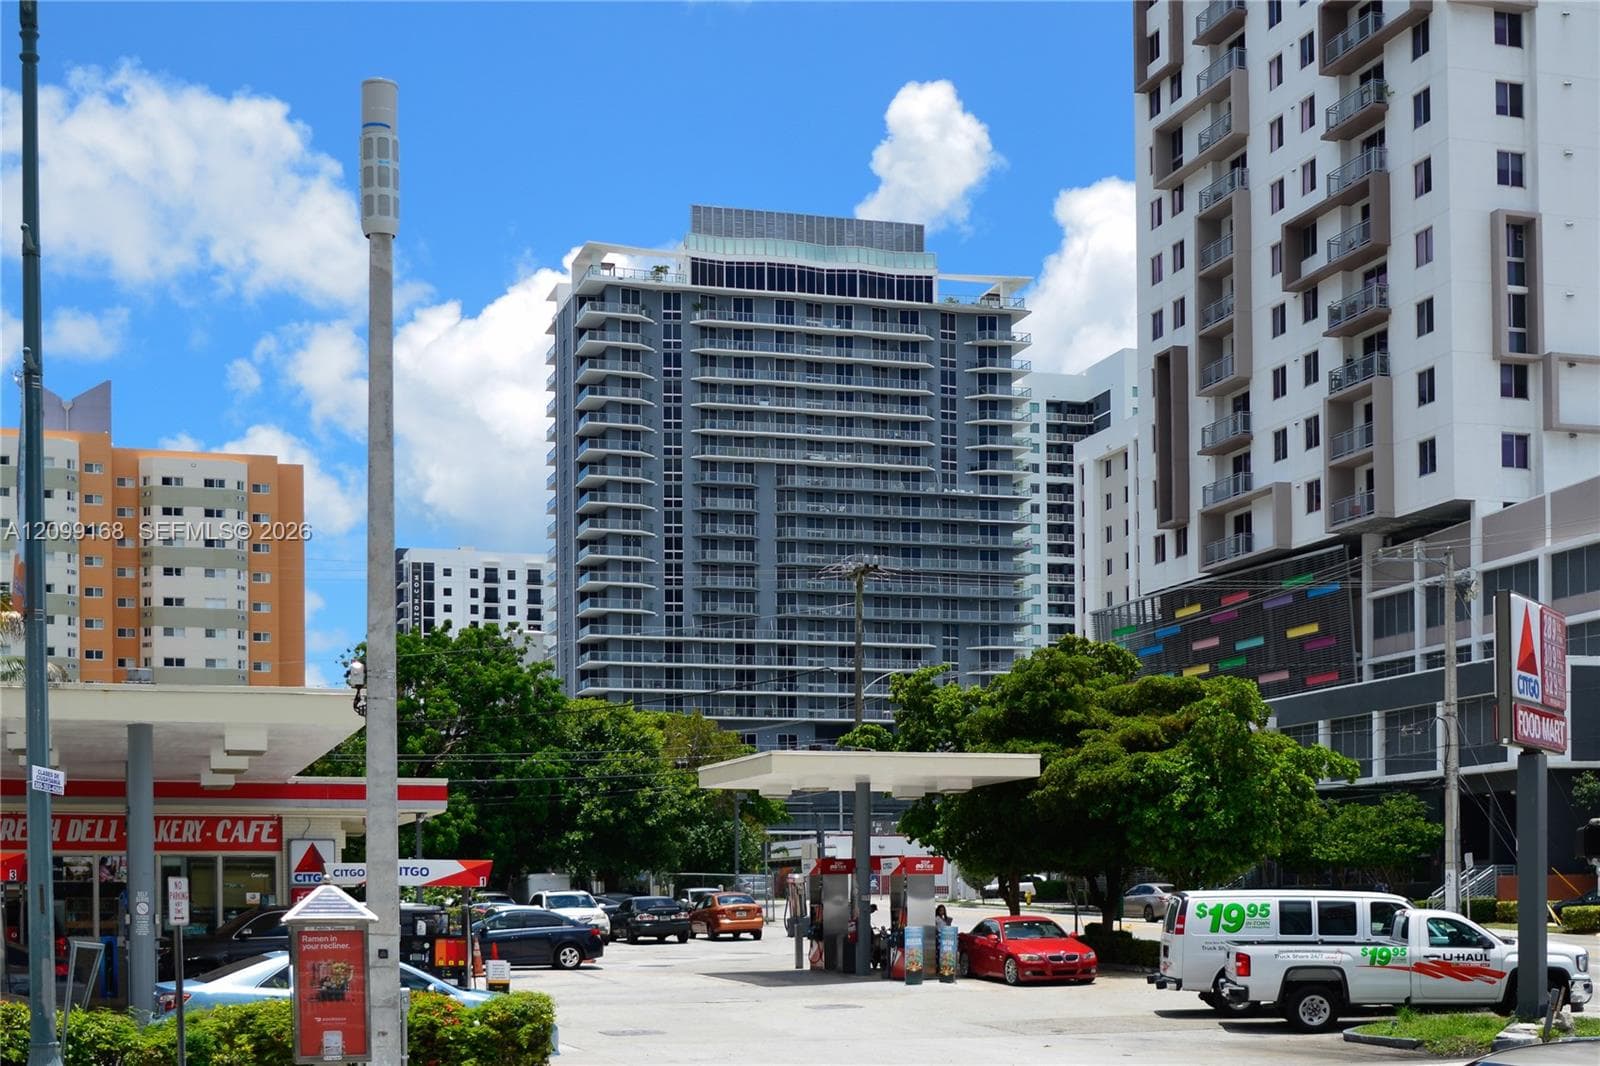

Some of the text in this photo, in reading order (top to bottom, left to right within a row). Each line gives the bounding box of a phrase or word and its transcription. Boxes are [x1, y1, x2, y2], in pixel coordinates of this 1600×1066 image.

[1517, 675, 1540, 699] CITGO
[1518, 710, 1565, 745] FOOD MART
[66, 819, 118, 842] DELI
[10, 870, 16, 880] 3
[333, 867, 430, 878] CITGO ITGO
[294, 873, 322, 883] CITG
[481, 877, 486, 886] 1
[174, 880, 182, 889] NO
[302, 943, 319, 951] your
[1443, 953, 1490, 962] U-HAUL
